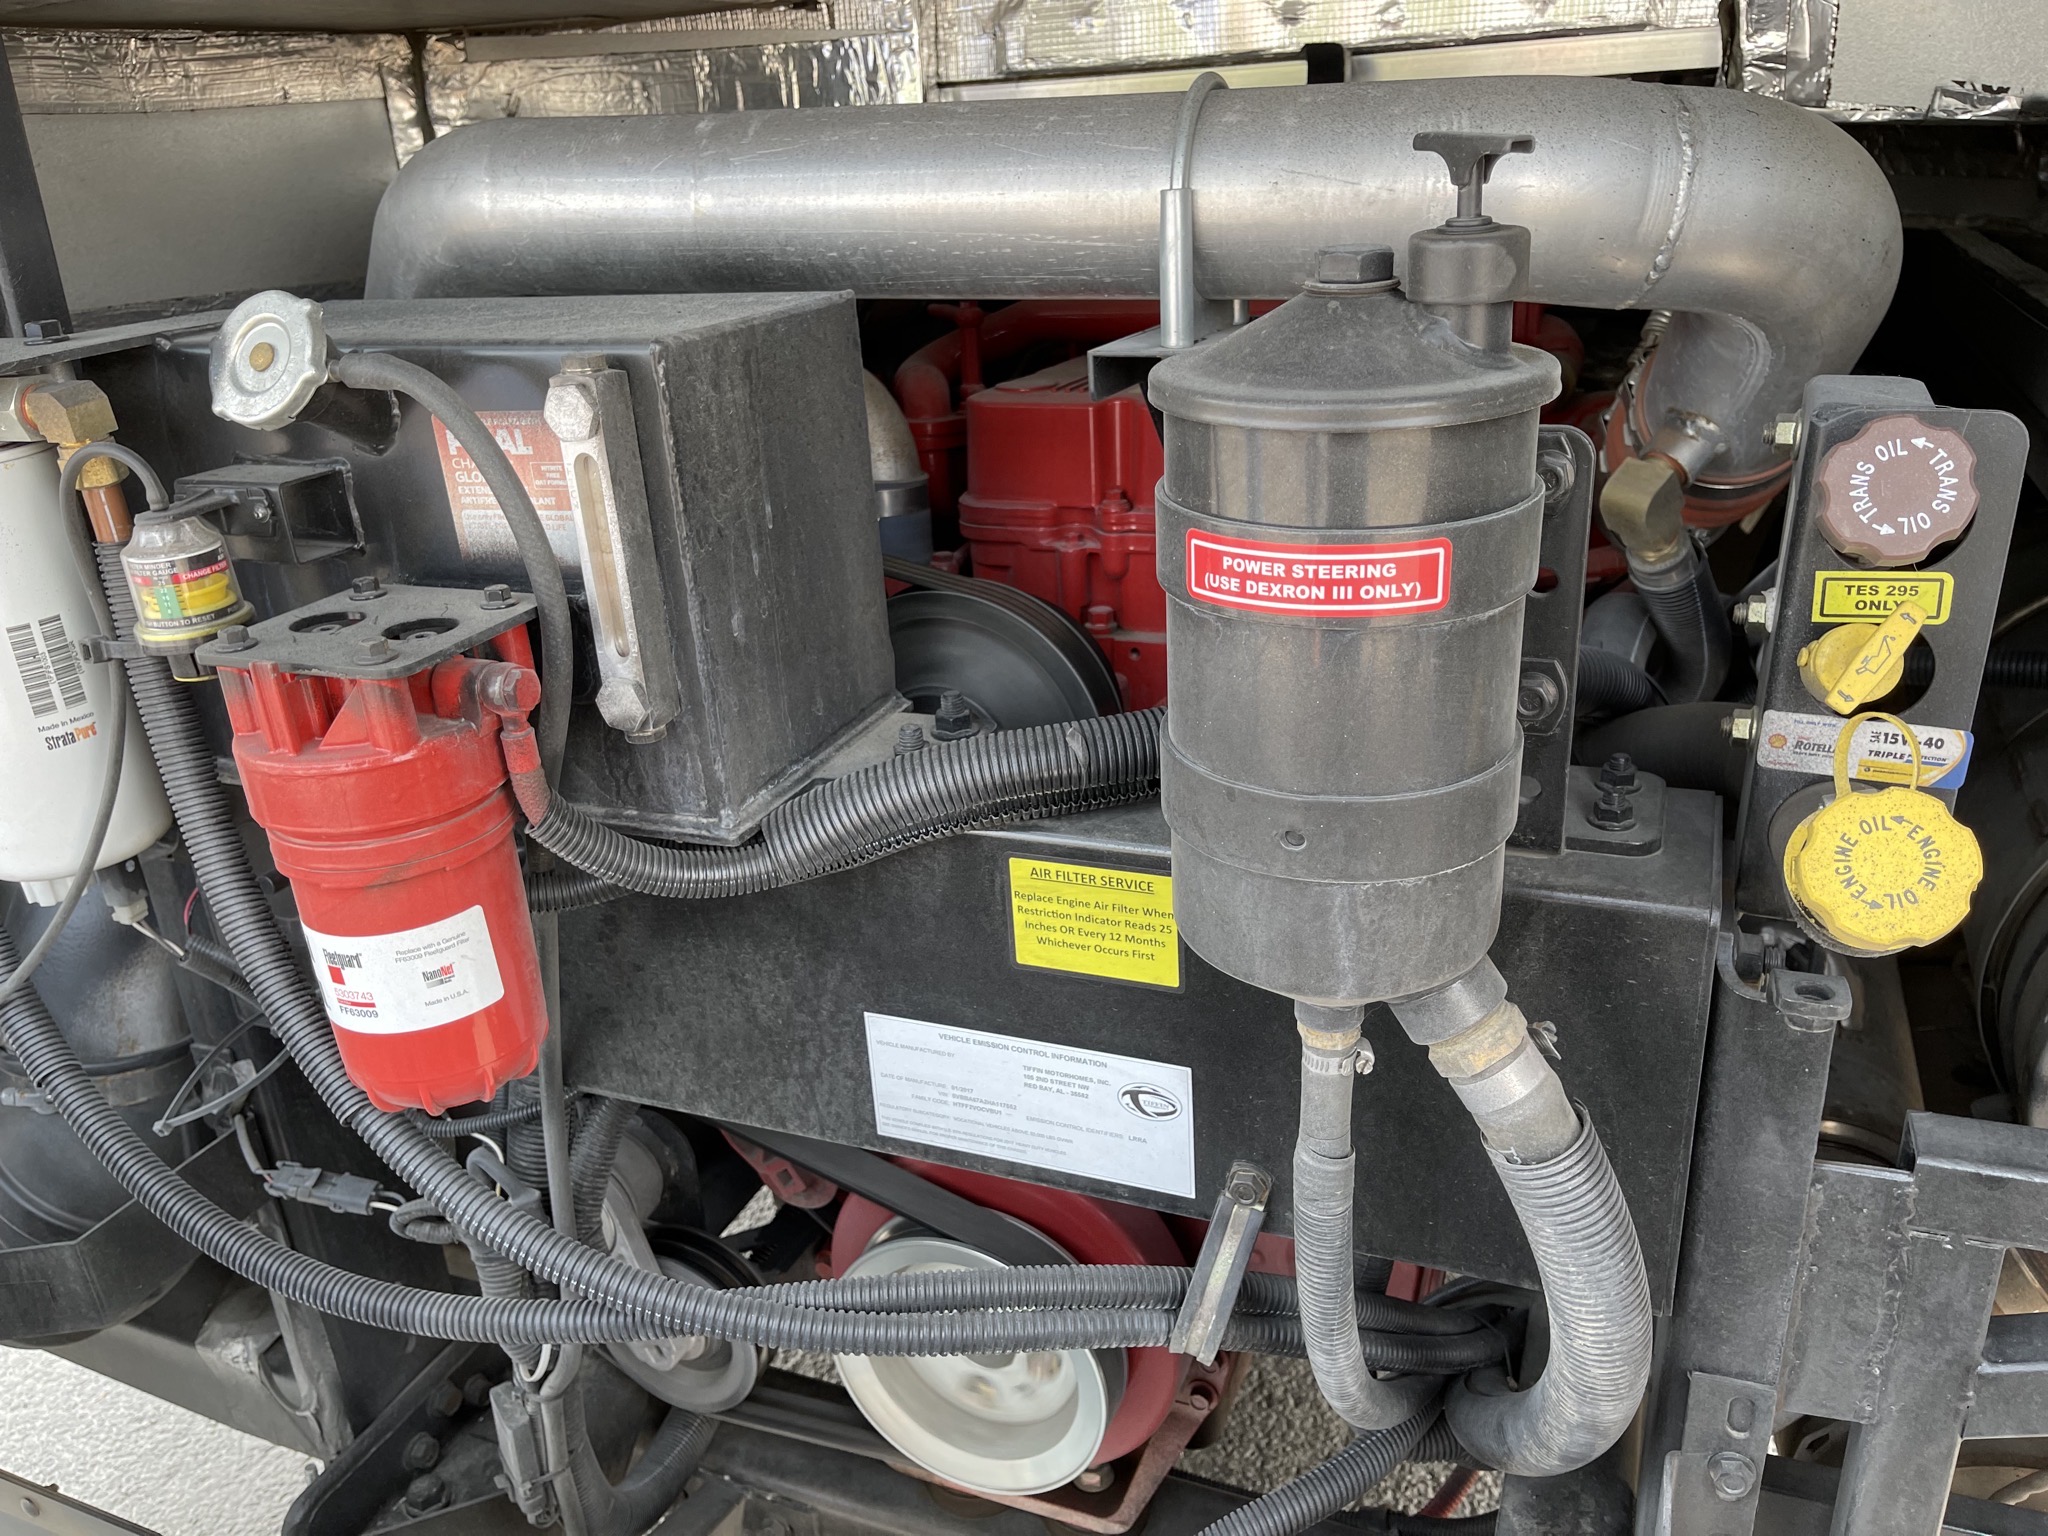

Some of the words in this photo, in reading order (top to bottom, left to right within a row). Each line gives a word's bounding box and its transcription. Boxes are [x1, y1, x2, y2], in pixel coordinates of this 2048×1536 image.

[446, 428, 533, 455] FAL
[1848, 461, 1878, 524] TRANS
[1875, 438, 1909, 462] OIL
[1929, 448, 1959, 514] TRANS
[1897, 512, 1932, 535] OIL
[182, 568, 211, 580] CHANGE
[1223, 556, 1286, 578] POWER
[1291, 562, 1397, 579] STEERING
[1204, 572, 1240, 592] (USE
[1246, 580, 1326, 600] DEXRON
[1332, 586, 1353, 600] III
[1359, 581, 1421, 600] ONLY)
[1844, 585, 1880, 596] TES
[1885, 585, 1919, 597] 295
[180, 618, 191, 626] TO
[193, 614, 215, 624] RESET
[37, 723, 60, 733] Made
[69, 712, 95, 724] Mexico
[45, 723, 97, 751] StrataPure
[1869, 731, 1881, 743] SAE
[1868, 750, 1906, 760] TRIPLE
[1907, 754, 1947, 762] PTECTION
[1833, 832, 1868, 900] ENGINE
[1858, 816, 1892, 835] OIL
[1906, 824, 1943, 892] ENGINE
[1030, 867, 1052, 879] AIR
[1055, 870, 1097, 885] FILTER
[1100, 875, 1154, 892] SERVICE
[1014, 890, 1054, 904] Replace
[1057, 895, 1091, 909] Engine
[1094, 901, 1109, 911] Air
[1112, 903, 1140, 915] Filter
[1142, 907, 1174, 920] When
[1883, 888, 1919, 910] OIL
[1017, 905, 1072, 920] Restriction
[1075, 911, 1122, 927] Indicator
[1124, 919, 1156, 933] Reads
[1159, 924, 1172, 934] 25
[395, 947, 422, 957] Replace
[441, 931, 466, 944] Genuine
[1025, 920, 1057, 933] Inches
[1059, 925, 1075, 935] OR
[1078, 927, 1106, 942] Every
[1109, 932, 1121, 942] 12
[1125, 935, 1166, 948] Months
[322, 948, 362, 971] Fleetguard
[395, 953, 423, 963] FF63009
[424, 943, 456, 957] Fleetguard
[456, 937, 470, 946] Filter
[1036, 936, 1091, 952] Whichever
[1093, 944, 1129, 957] Occurs
[1132, 949, 1156, 961] First
[422, 963, 455, 982] NanoNet
[334, 987, 374, 1001] 5303743
[425, 999, 443, 1007] Made
[339, 1005, 379, 1018] FF63009
[938, 1033, 971, 1044] VEHICLE
[972, 1038, 1009, 1051] EMISSION
[1011, 1045, 1049, 1058] CONTROL
[1051, 1052, 1107, 1068] INFORMATION
[1022, 1065, 1042, 1073] TIFFIN
[1050, 1079, 1075, 1088] STREET
